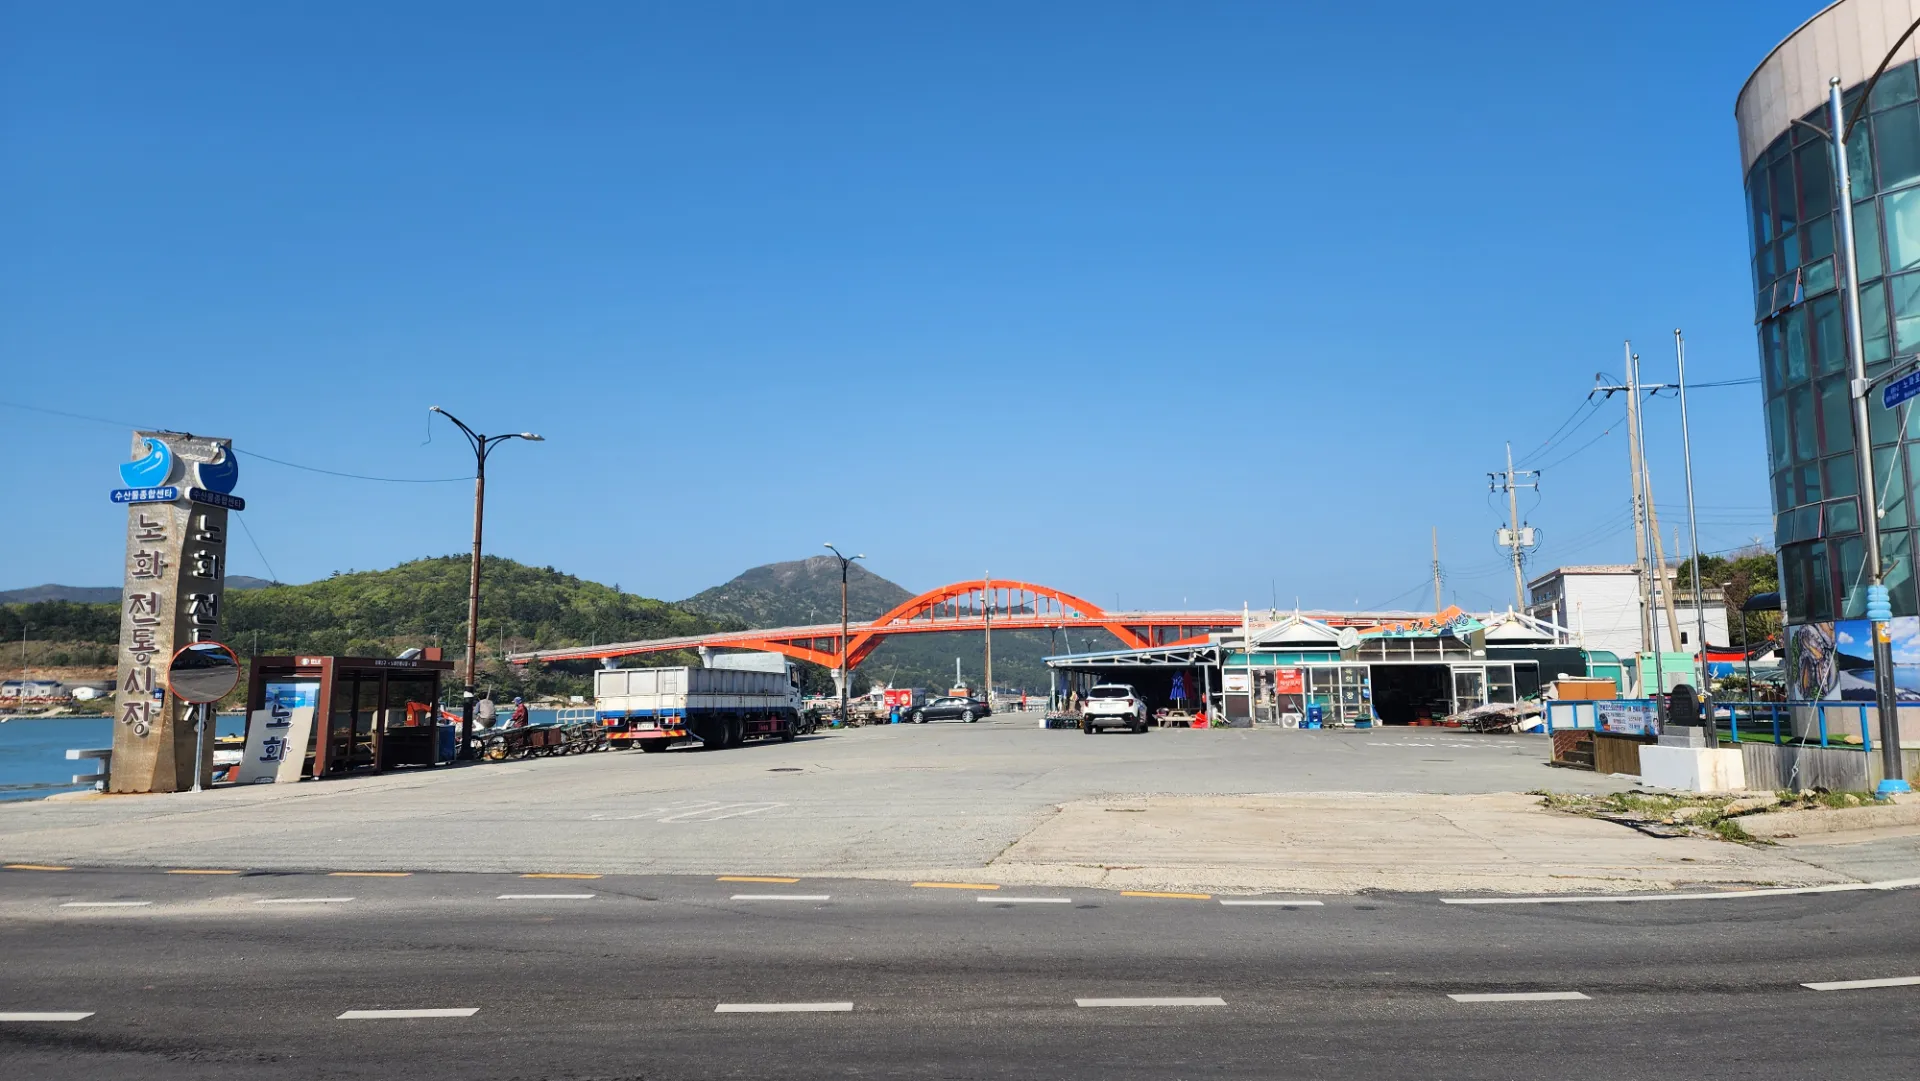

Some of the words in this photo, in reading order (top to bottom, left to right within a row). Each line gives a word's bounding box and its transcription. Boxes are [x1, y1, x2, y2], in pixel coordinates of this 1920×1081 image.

[115, 489, 173, 502] 수산물종합센타
[131, 513, 168, 580] 노화
[193, 514, 223, 580] 노화
[122, 591, 161, 738] 전통시장
[259, 703, 293, 763] 노화
